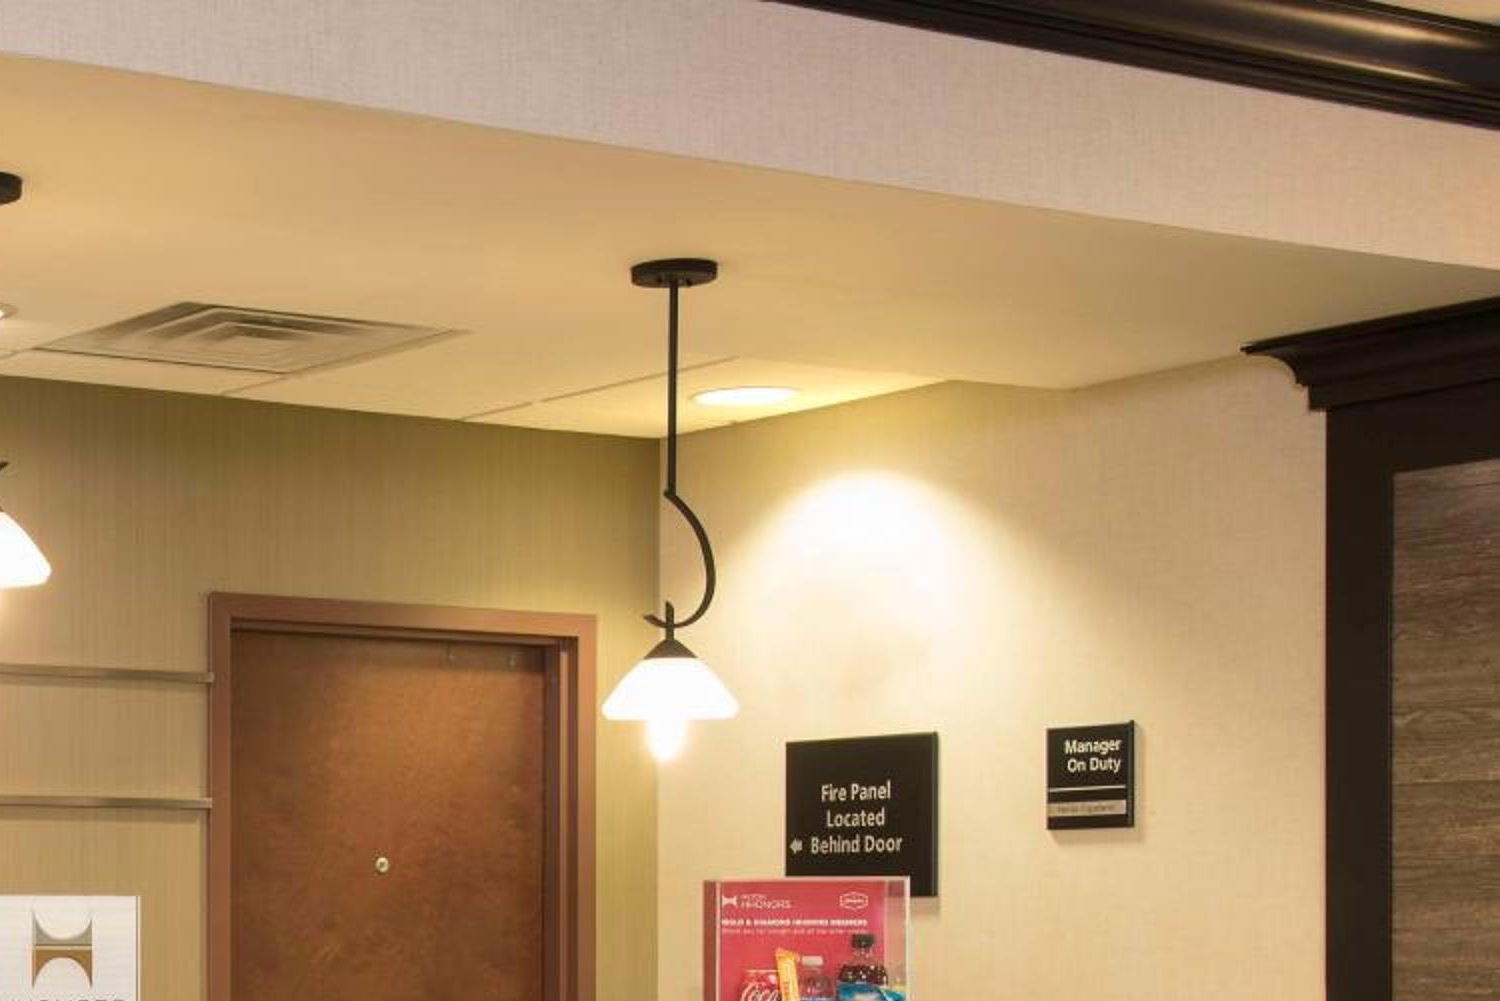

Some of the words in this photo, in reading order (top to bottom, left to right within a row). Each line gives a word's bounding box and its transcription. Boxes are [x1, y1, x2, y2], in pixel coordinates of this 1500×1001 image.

[1064, 739, 1122, 755] Manager
[1067, 758, 1087, 773] On
[1089, 757, 1122, 774] Duty
[821, 783, 847, 802] Fire
[851, 780, 891, 801] Panel
[826, 807, 885, 827] Located
[810, 835, 861, 854] Behind
[864, 834, 903, 853] Door
